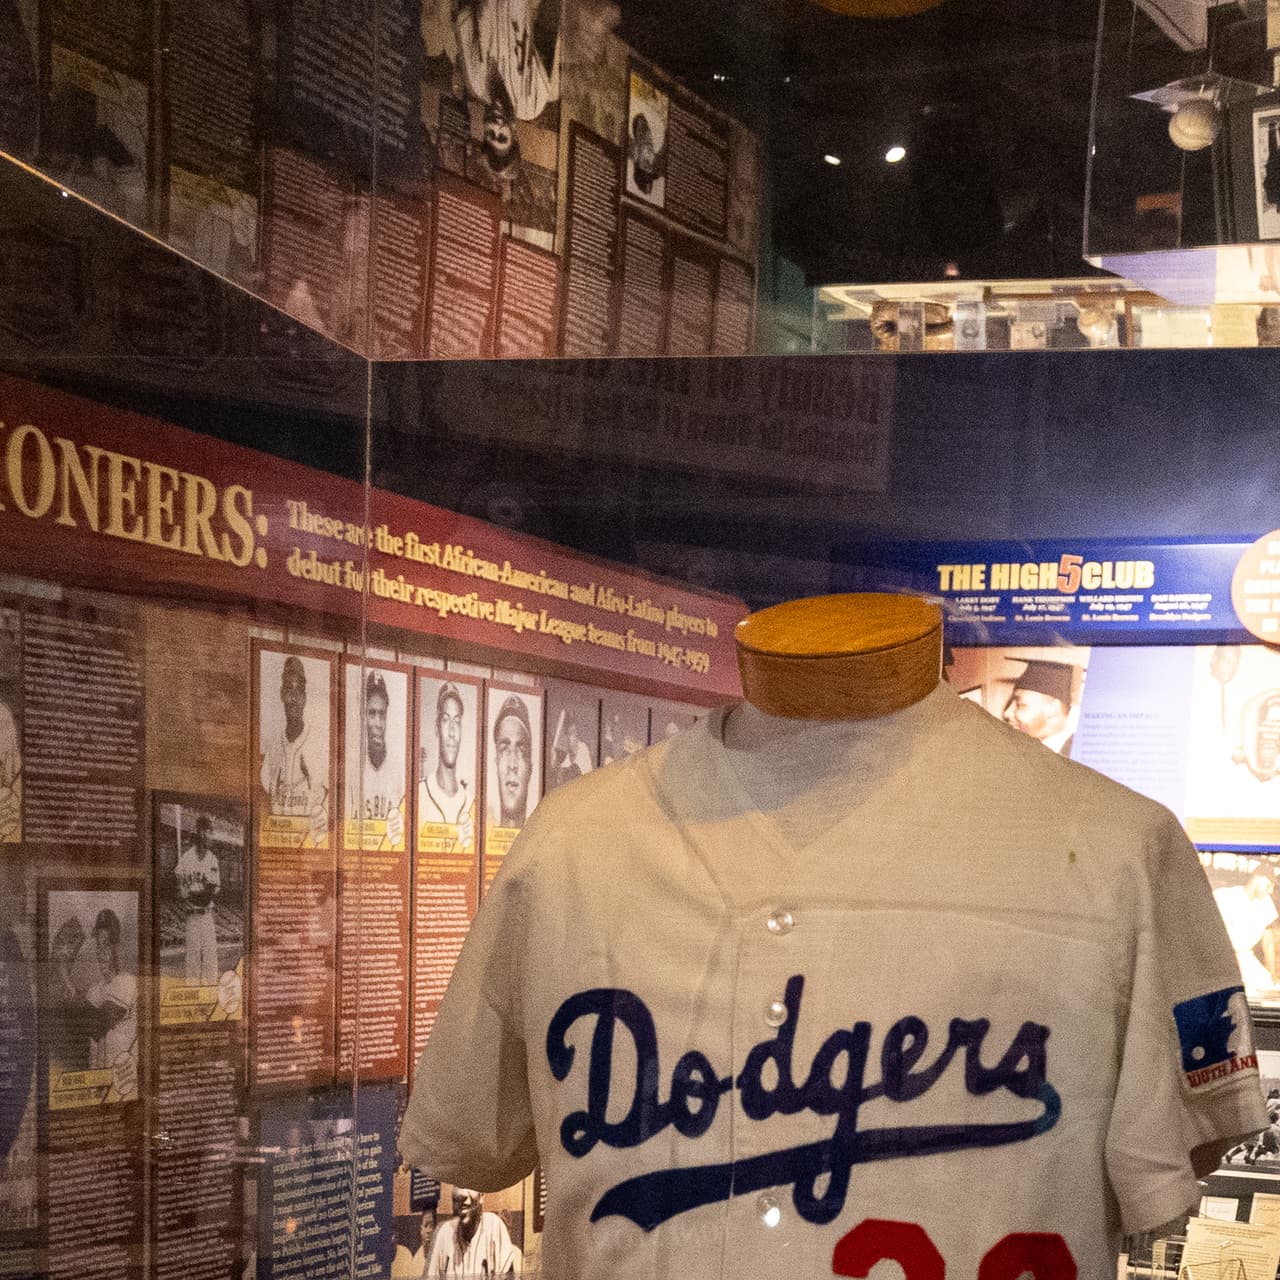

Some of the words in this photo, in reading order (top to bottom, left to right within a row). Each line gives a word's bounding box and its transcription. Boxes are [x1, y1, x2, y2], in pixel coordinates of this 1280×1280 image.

[287, 500, 344, 539] These
[374, 525, 404, 555] the
[405, 531, 442, 564] first
[443, 544, 569, 601] African-American
[570, 583, 596, 608] and
[598, 586, 665, 624] Afro-Latino
[665, 606, 705, 637] players
[706, 618, 718, 638] to
[287, 547, 341, 587] debut
[371, 569, 414, 604] their
[416, 588, 494, 621] respective
[495, 599, 537, 632] Major
[538, 609, 588, 645] League
[588, 622, 626, 651] teams
[626, 628, 656, 655] from
[937, 564, 985, 591] THE
[990, 562, 1059, 591] HIGH
[1056, 553, 1084, 594] 5
[1082, 560, 1155, 590] CLUB
[545, 973, 1065, 1232] Dodgers
